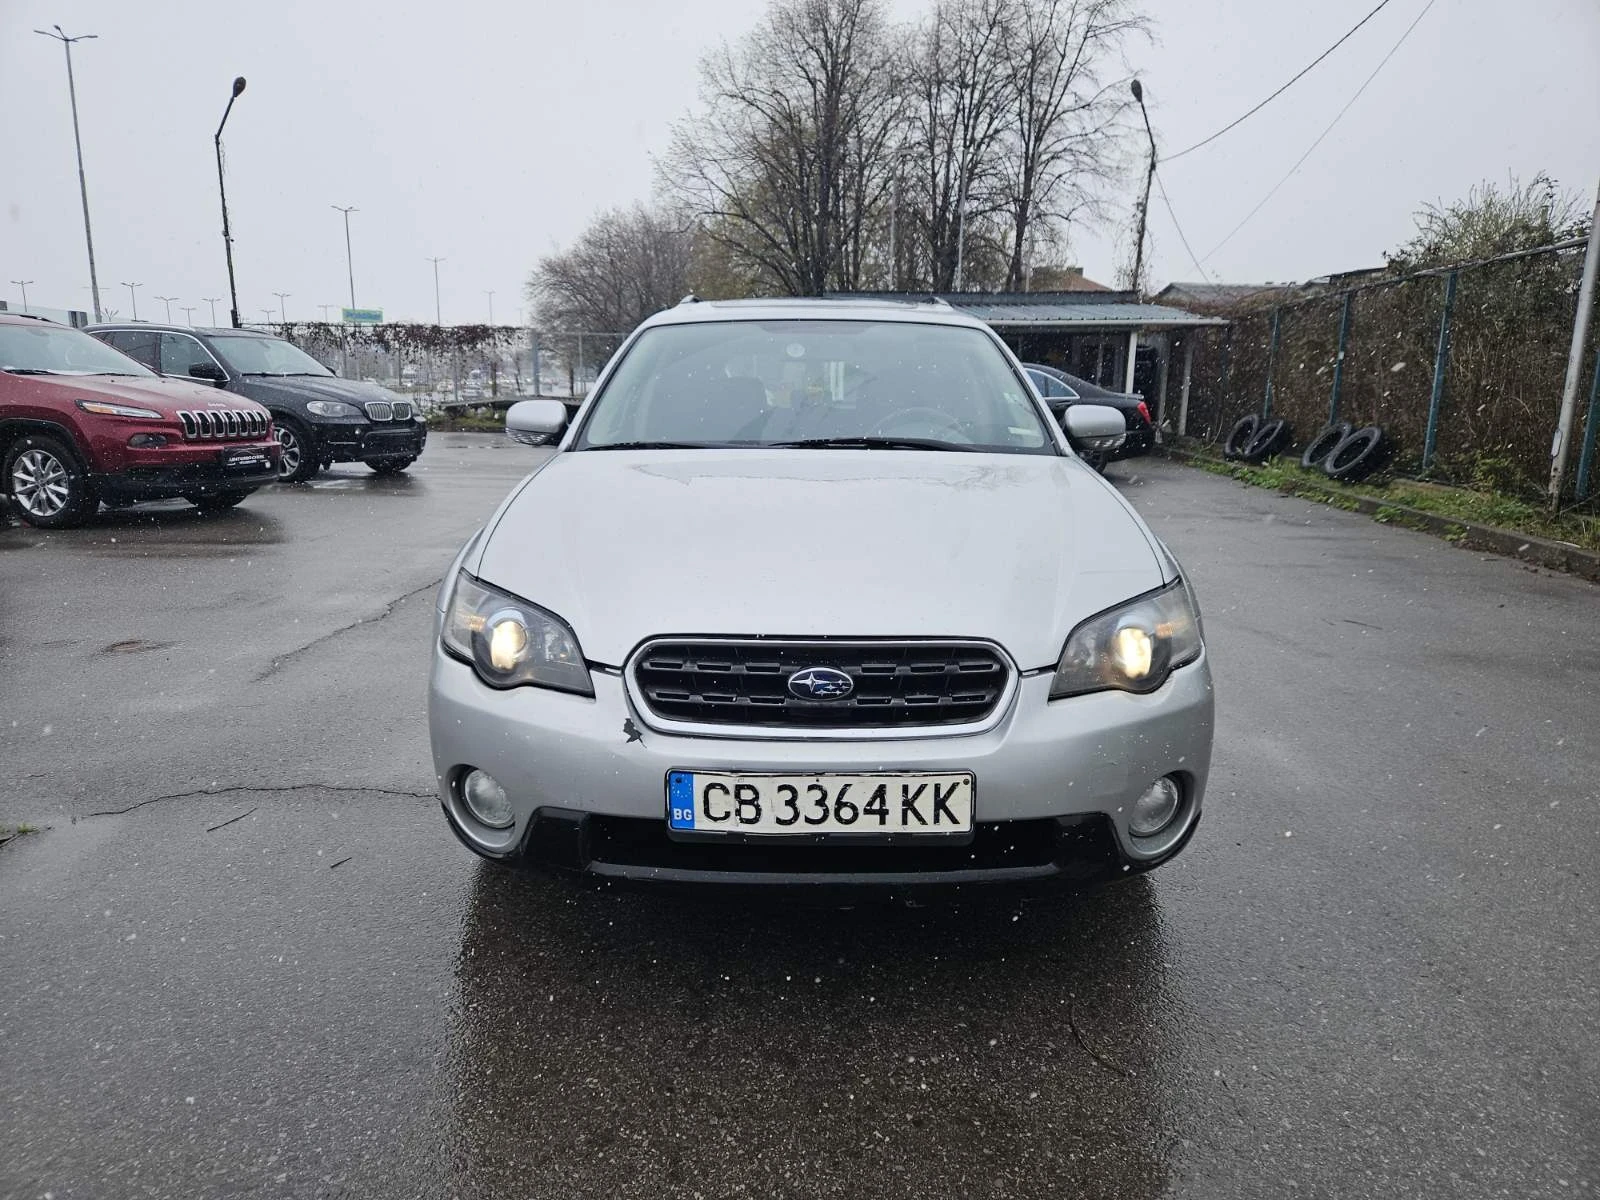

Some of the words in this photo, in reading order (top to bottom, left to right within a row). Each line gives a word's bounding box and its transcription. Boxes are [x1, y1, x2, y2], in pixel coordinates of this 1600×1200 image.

[673, 808, 693, 820] BG
[703, 782, 761, 825] CB
[775, 783, 889, 826] 3364
[901, 782, 961, 825] KK
